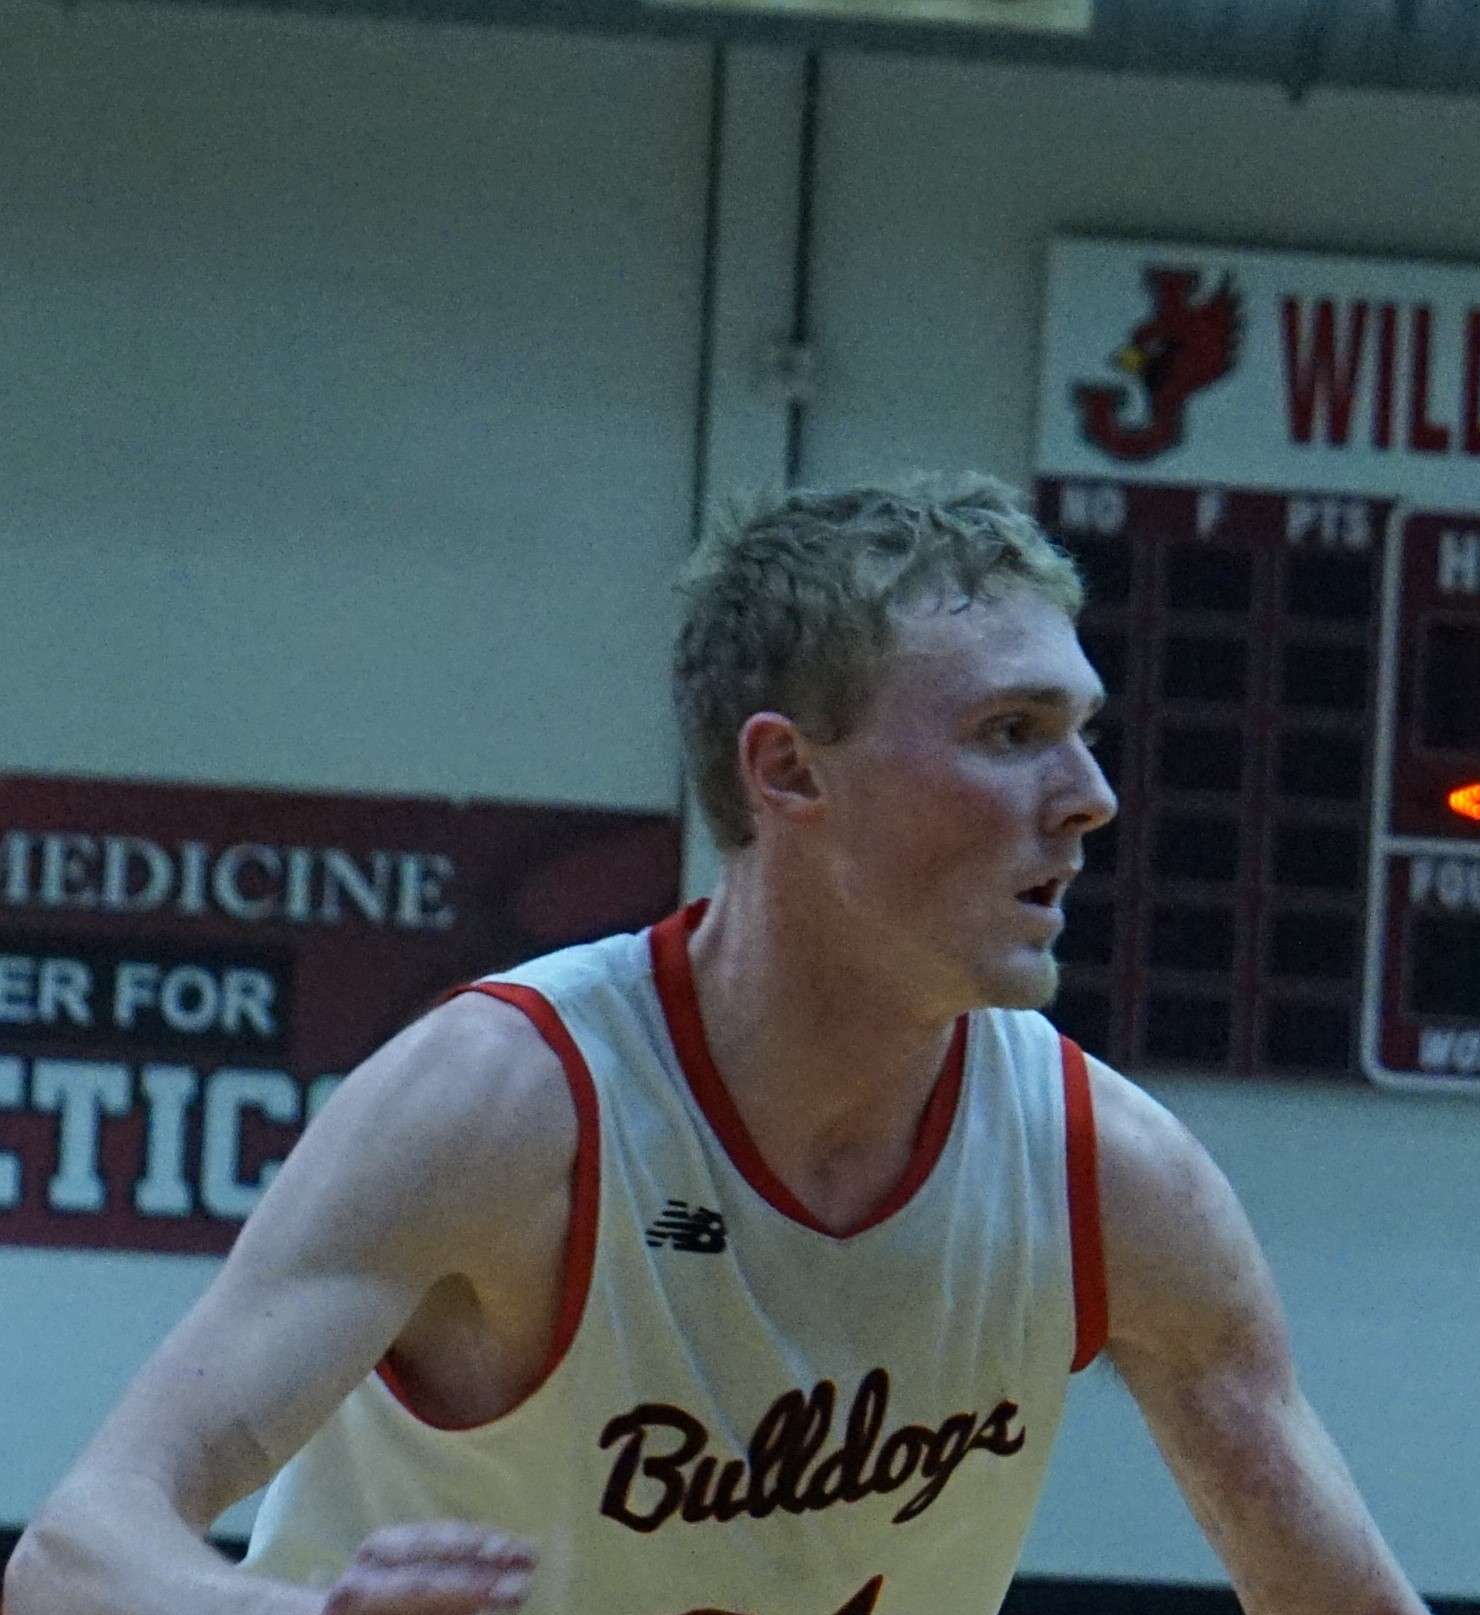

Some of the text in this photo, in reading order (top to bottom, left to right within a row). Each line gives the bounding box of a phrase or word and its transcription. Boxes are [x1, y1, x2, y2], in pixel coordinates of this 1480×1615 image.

[1287, 499, 1370, 551] PTS
[113, 960, 278, 1039] FOR
[598, 1366, 1027, 1533] Bulldogs
